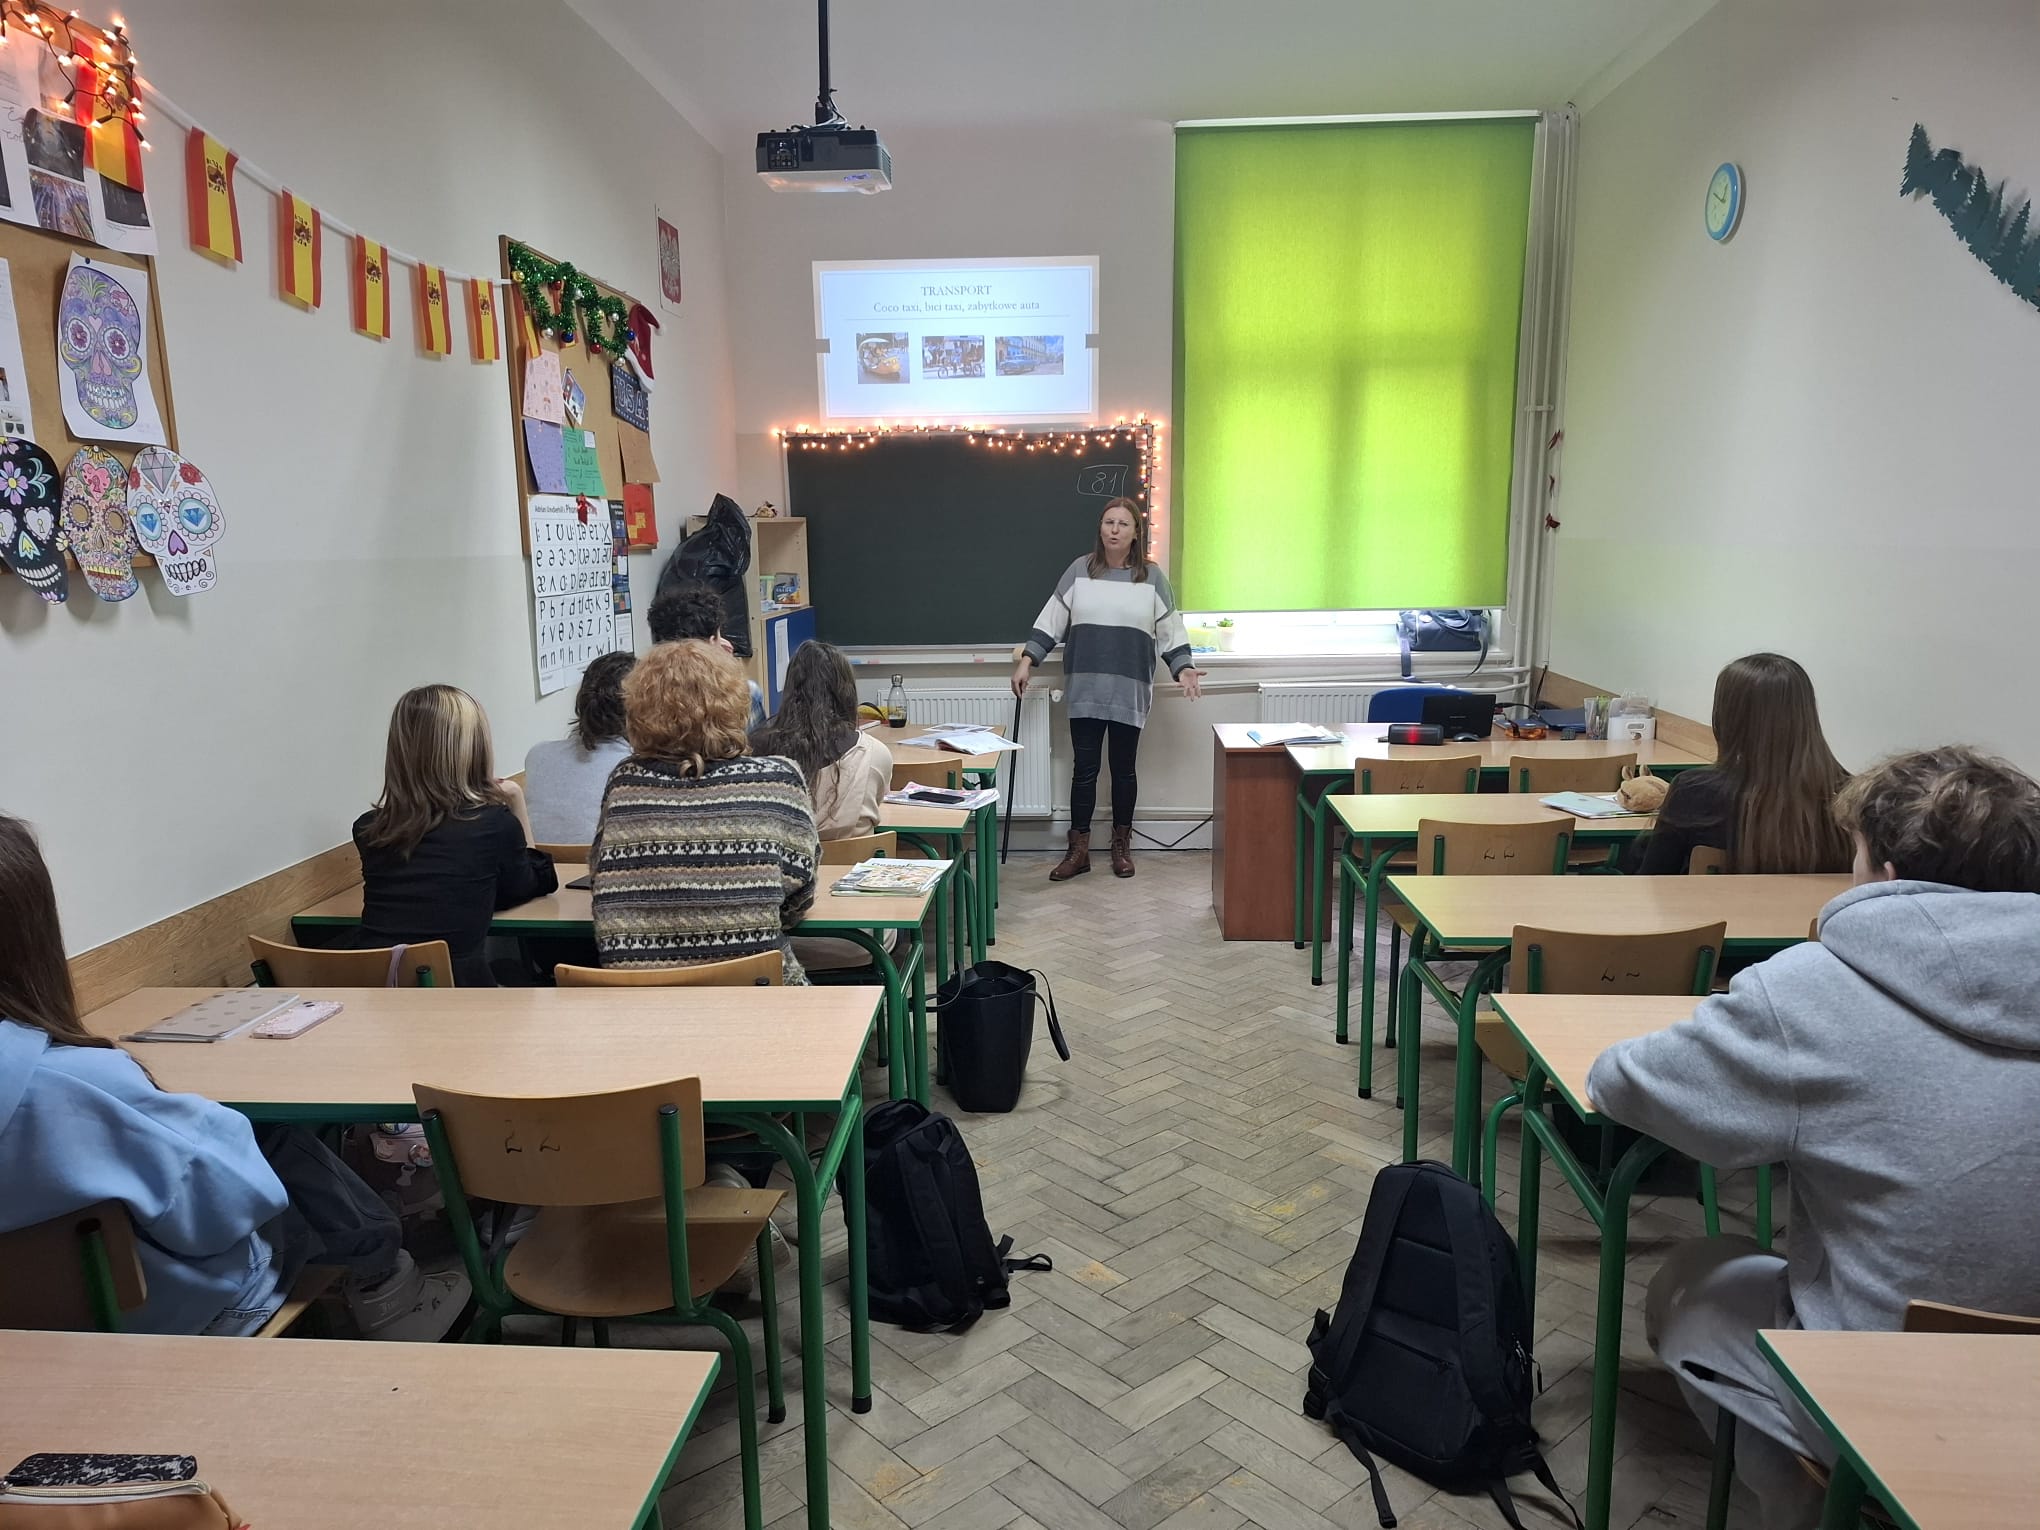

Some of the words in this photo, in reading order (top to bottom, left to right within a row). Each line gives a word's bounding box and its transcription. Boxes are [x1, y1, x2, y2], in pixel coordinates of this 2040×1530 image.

[921, 285, 992, 296] TRANSPORT
[874, 302, 899, 313] Coco
[902, 302, 922, 313] taxi,
[925, 301, 942, 311] bici
[945, 301, 964, 312] taxi,
[968, 301, 1017, 313] zabytkowe
[1020, 301, 1040, 310] auta
[616, 376, 645, 420] USA
[1092, 472, 1117, 493] 81
